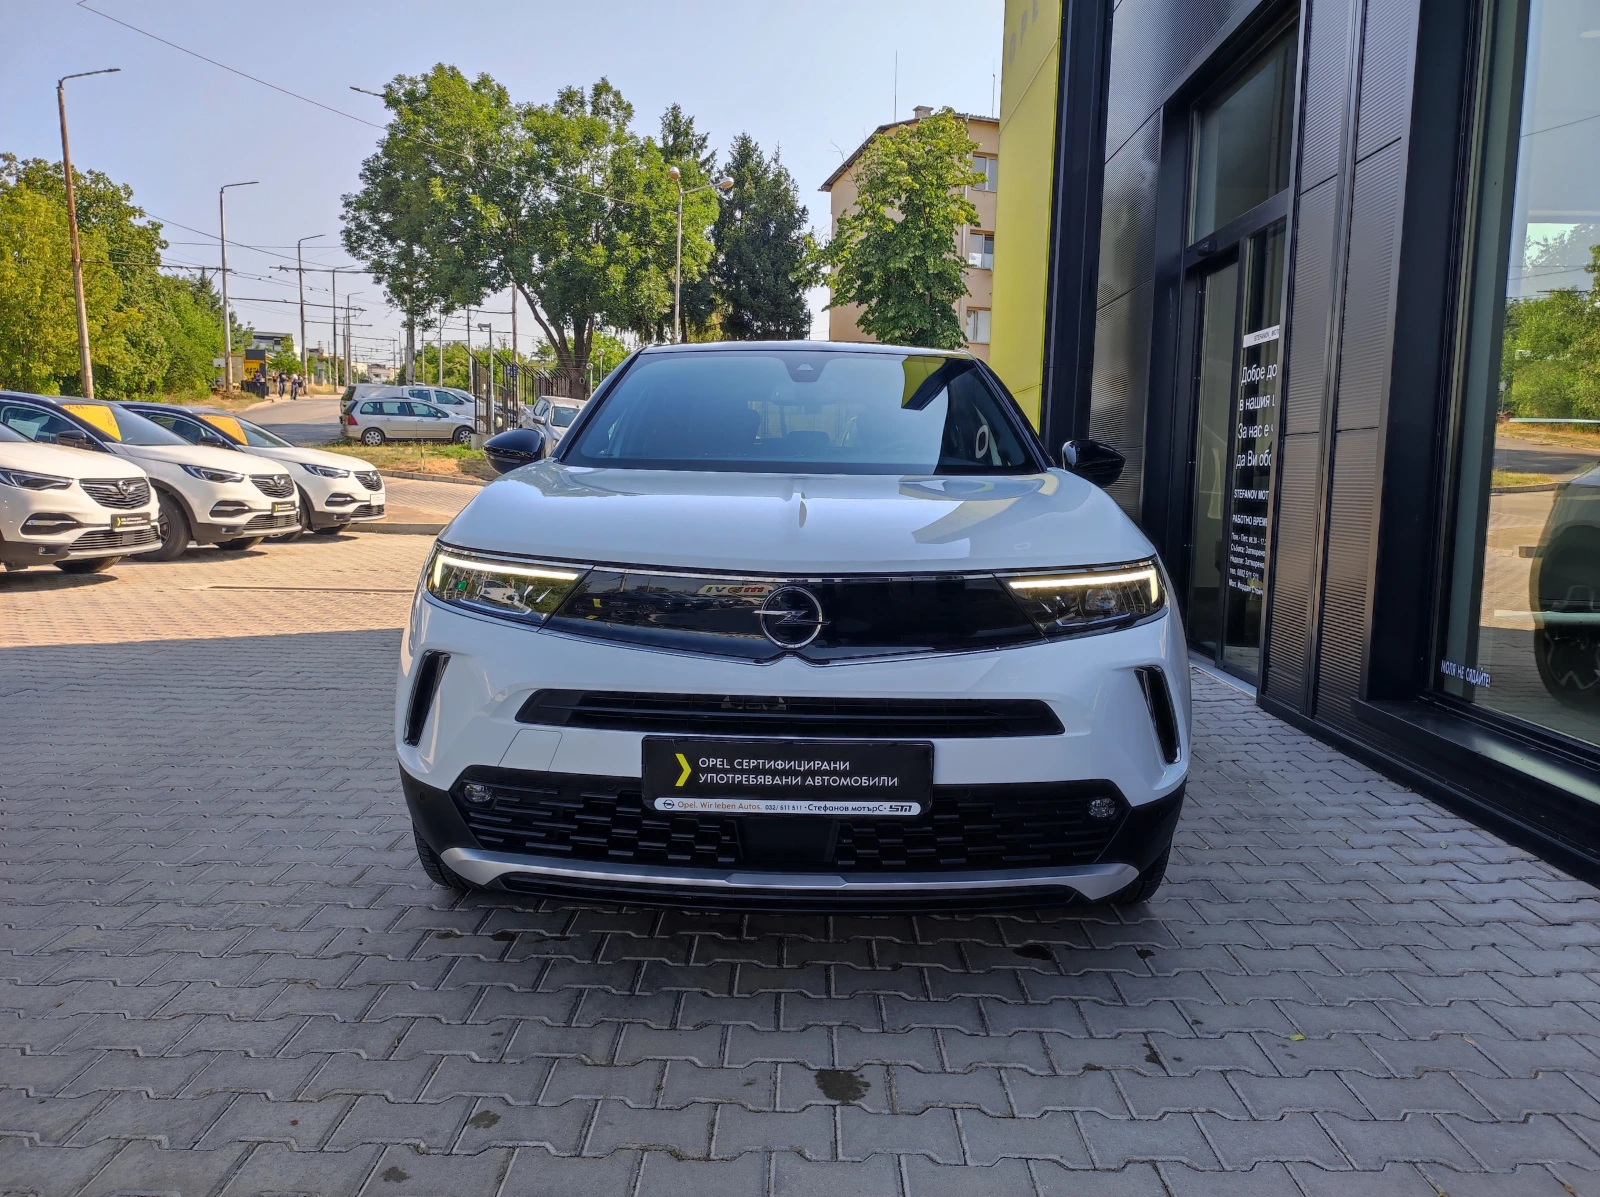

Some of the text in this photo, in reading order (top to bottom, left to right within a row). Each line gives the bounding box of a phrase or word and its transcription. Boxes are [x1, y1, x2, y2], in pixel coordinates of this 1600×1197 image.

[1241, 363, 1278, 386] Добре до
[1239, 399, 1244, 411] в
[1245, 395, 1270, 410] нашия
[1238, 423, 1247, 438] За
[1248, 425, 1263, 438] нас
[1264, 424, 1269, 437] е
[1235, 454, 1246, 469] да
[1247, 450, 1258, 467] Ви
[1234, 489, 1258, 500] STEFANOV
[1232, 514, 1253, 525] РАБОТНО
[1456, 665, 1464, 680] НЕ
[698, 757, 850, 772] OPEL СЕРТИФИЦИРАНИ
[698, 773, 899, 787] УПОТРЕБЯВАНИ АВТОМОБИЛИ
[700, 801, 713, 809] Wir
[714, 801, 736, 810] leben
